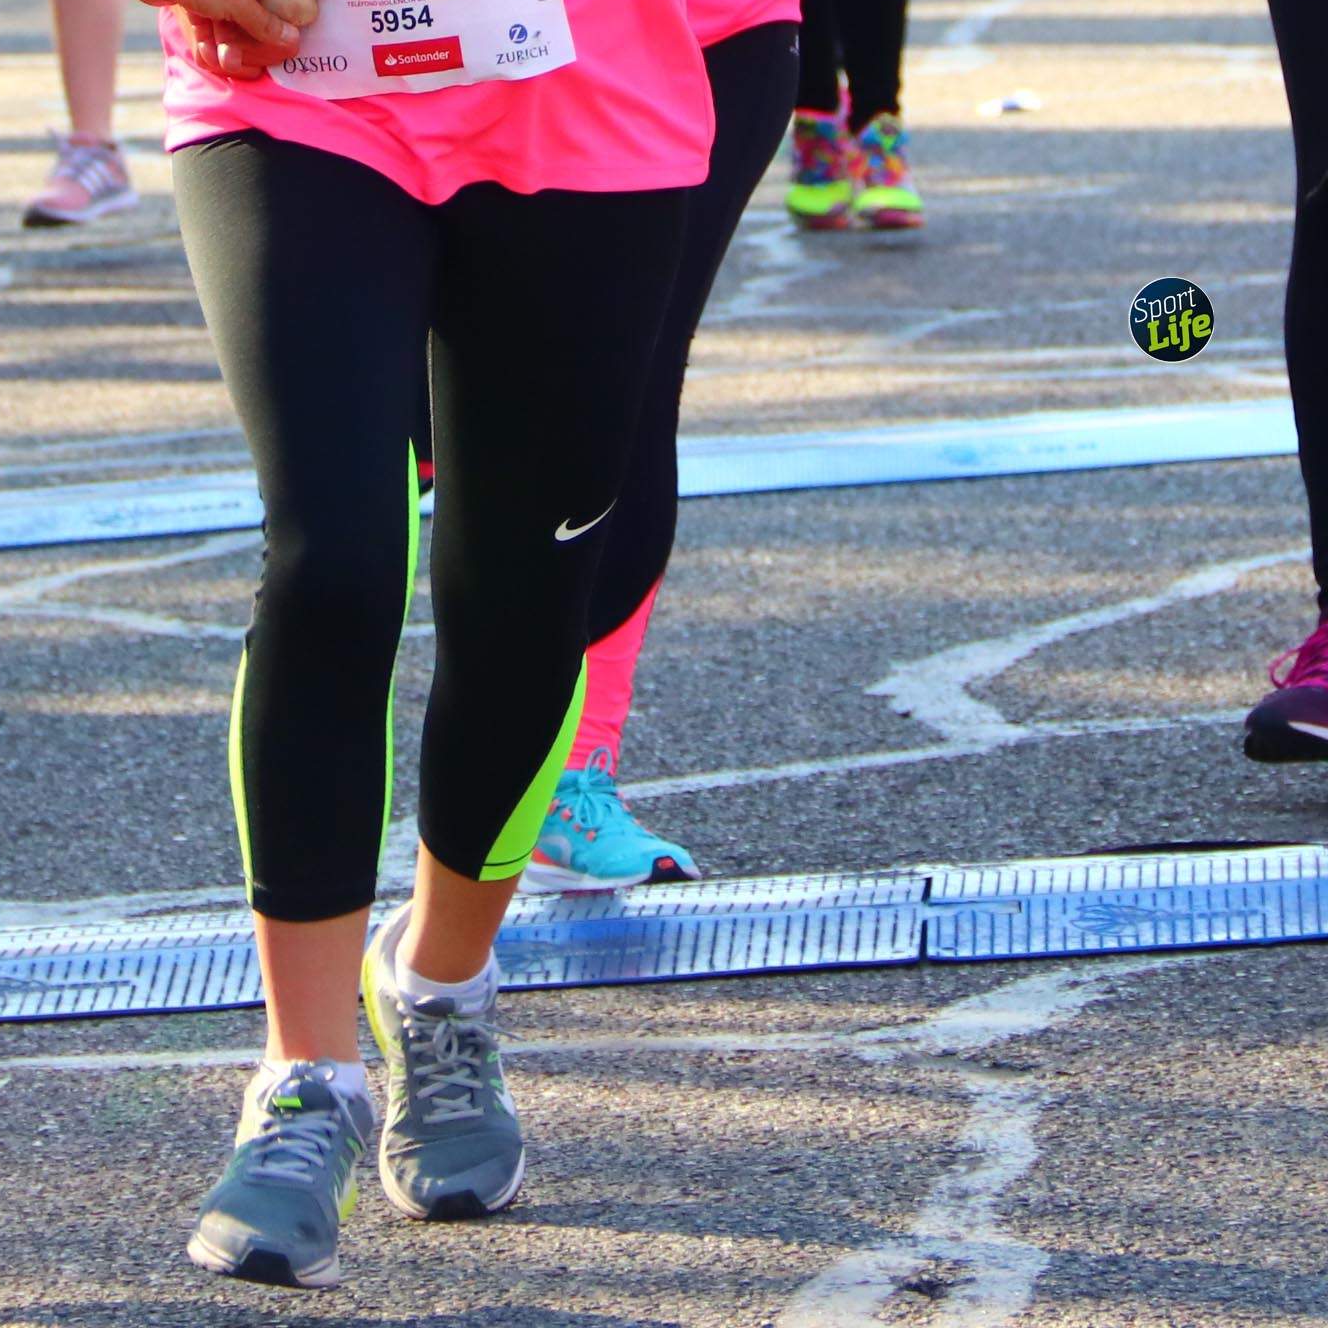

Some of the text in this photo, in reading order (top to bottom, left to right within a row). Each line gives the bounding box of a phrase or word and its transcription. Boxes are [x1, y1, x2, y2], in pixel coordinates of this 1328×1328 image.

[372, 4, 434, 33] 5954
[283, 55, 348, 74] OYSHO
[398, 50, 450, 65] Santander
[496, 45, 549, 65] ZURICH
